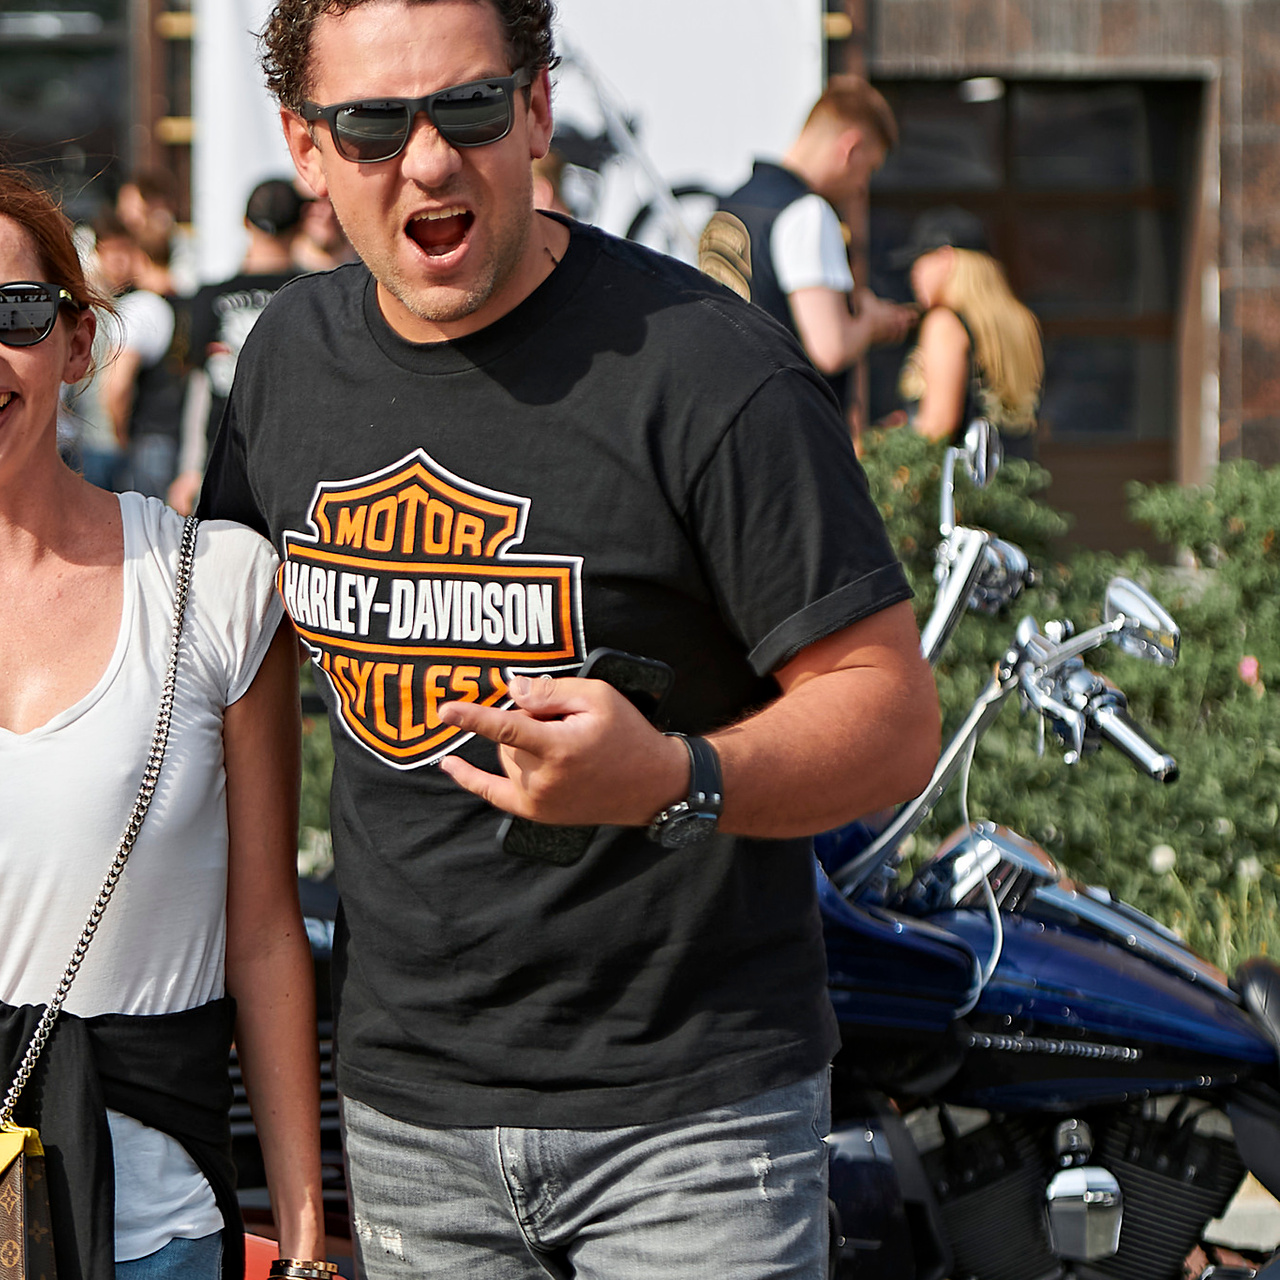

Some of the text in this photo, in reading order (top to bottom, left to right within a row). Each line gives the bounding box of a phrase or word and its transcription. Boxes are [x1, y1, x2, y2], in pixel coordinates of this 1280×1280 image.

[335, 483, 485, 556] MOTOR
[283, 560, 554, 645] HARLEY-DAVIDSON
[333, 653, 482, 741] CYCLES
